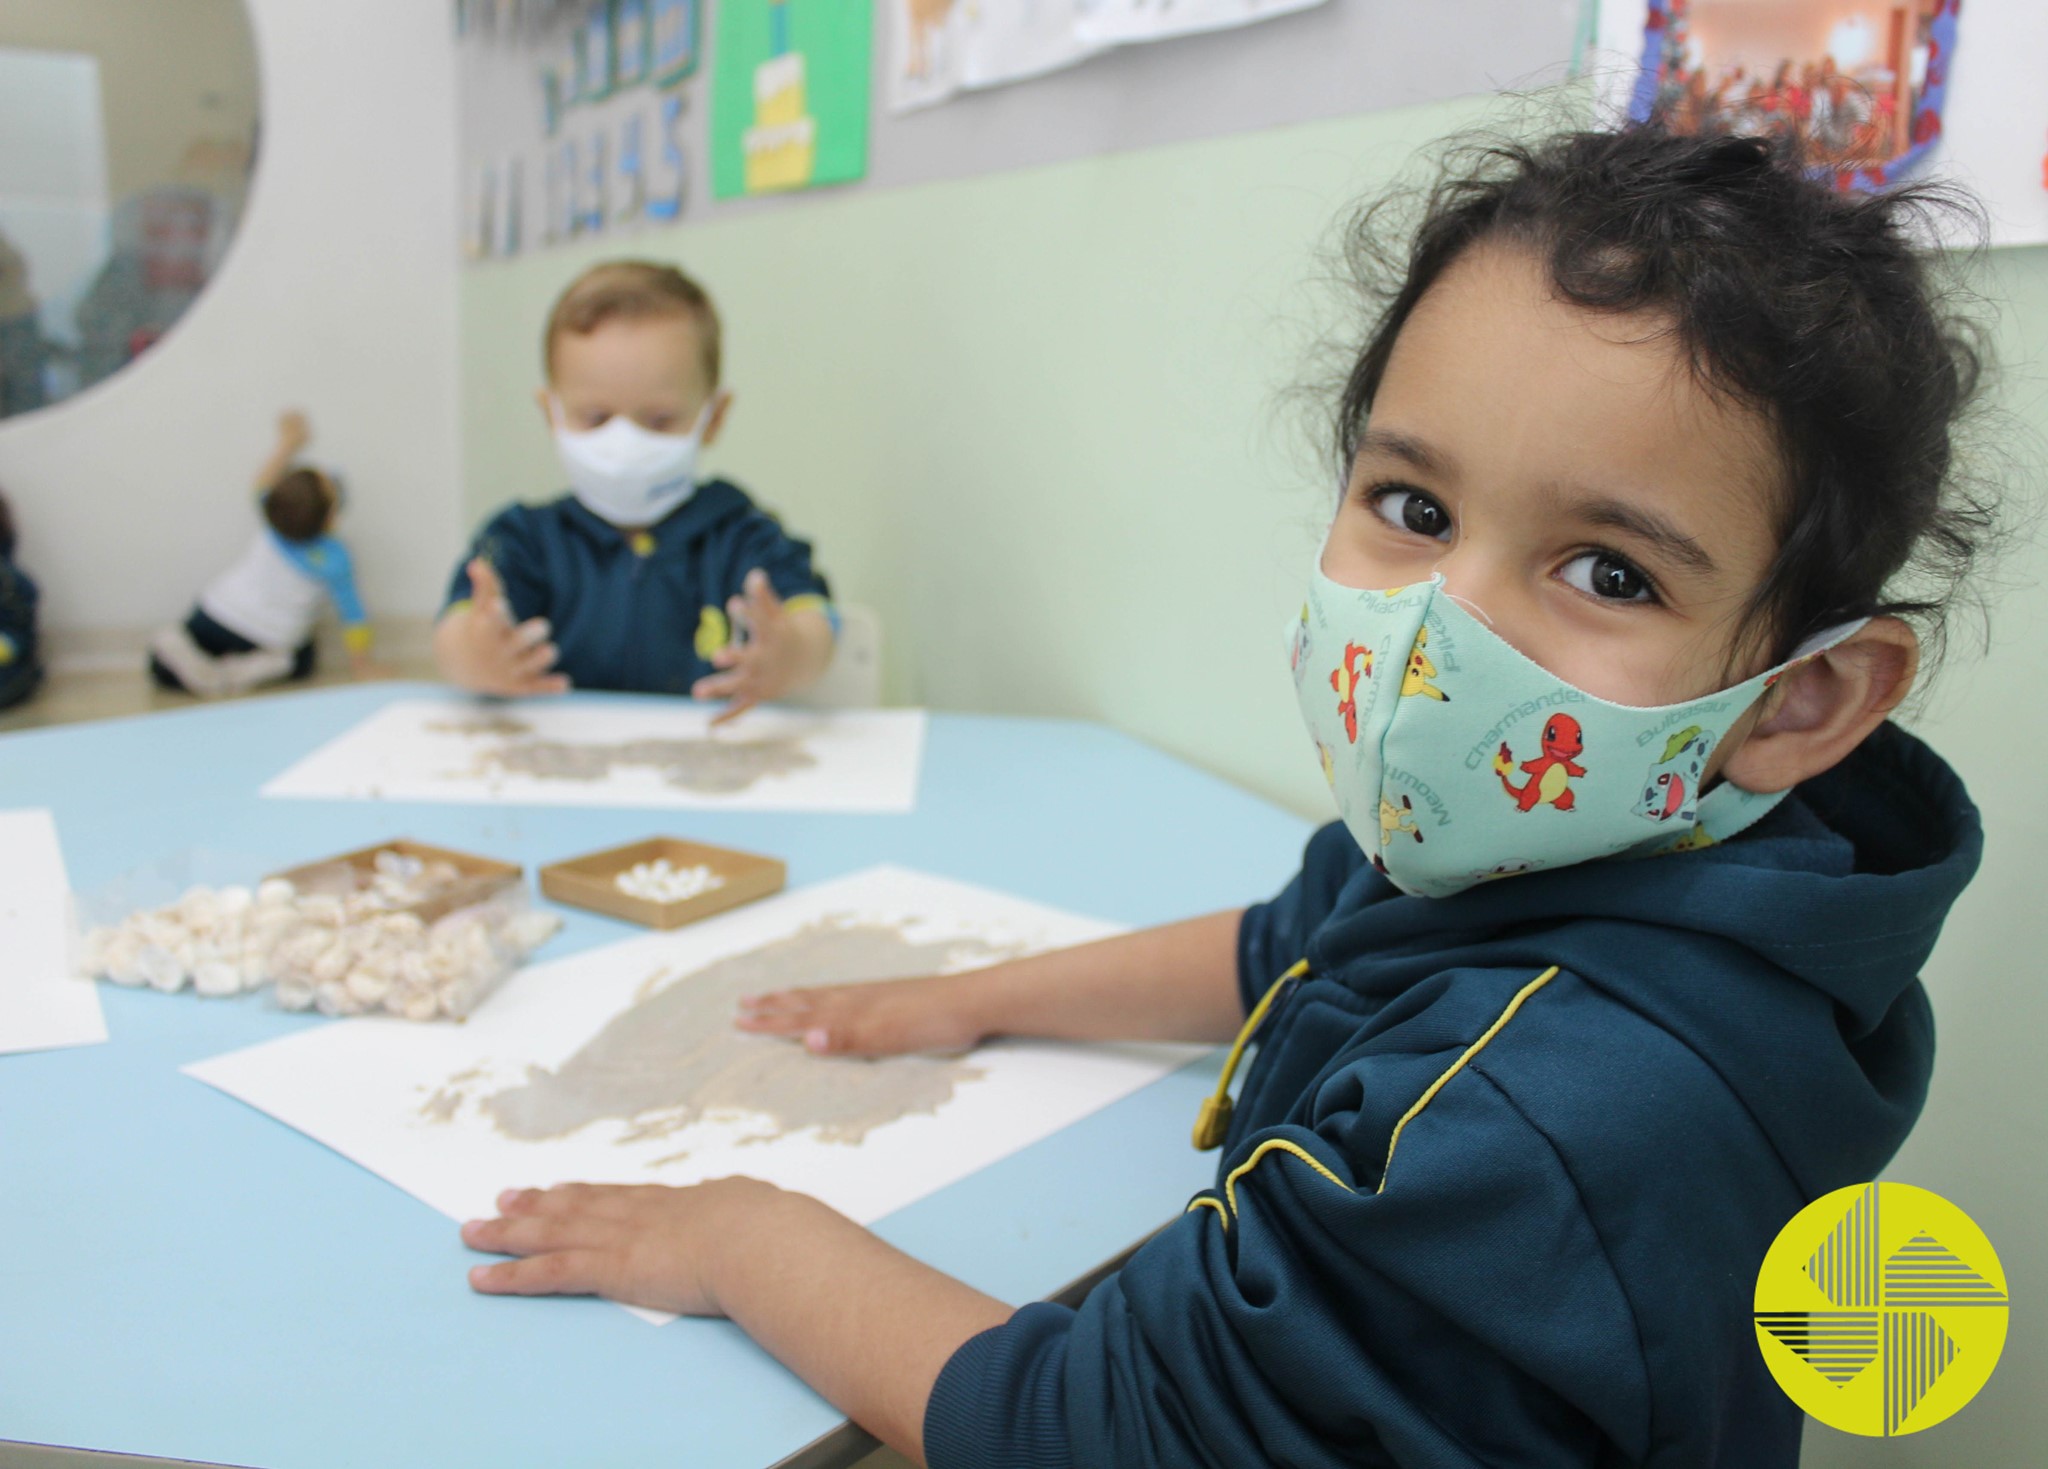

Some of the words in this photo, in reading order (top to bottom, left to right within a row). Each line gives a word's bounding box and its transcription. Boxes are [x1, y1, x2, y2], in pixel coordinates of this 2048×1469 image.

[1357, 591, 1423, 614] Pikachu
[1426, 609, 1462, 672] Pika
[1635, 701, 1732, 748] Bulbasaur
